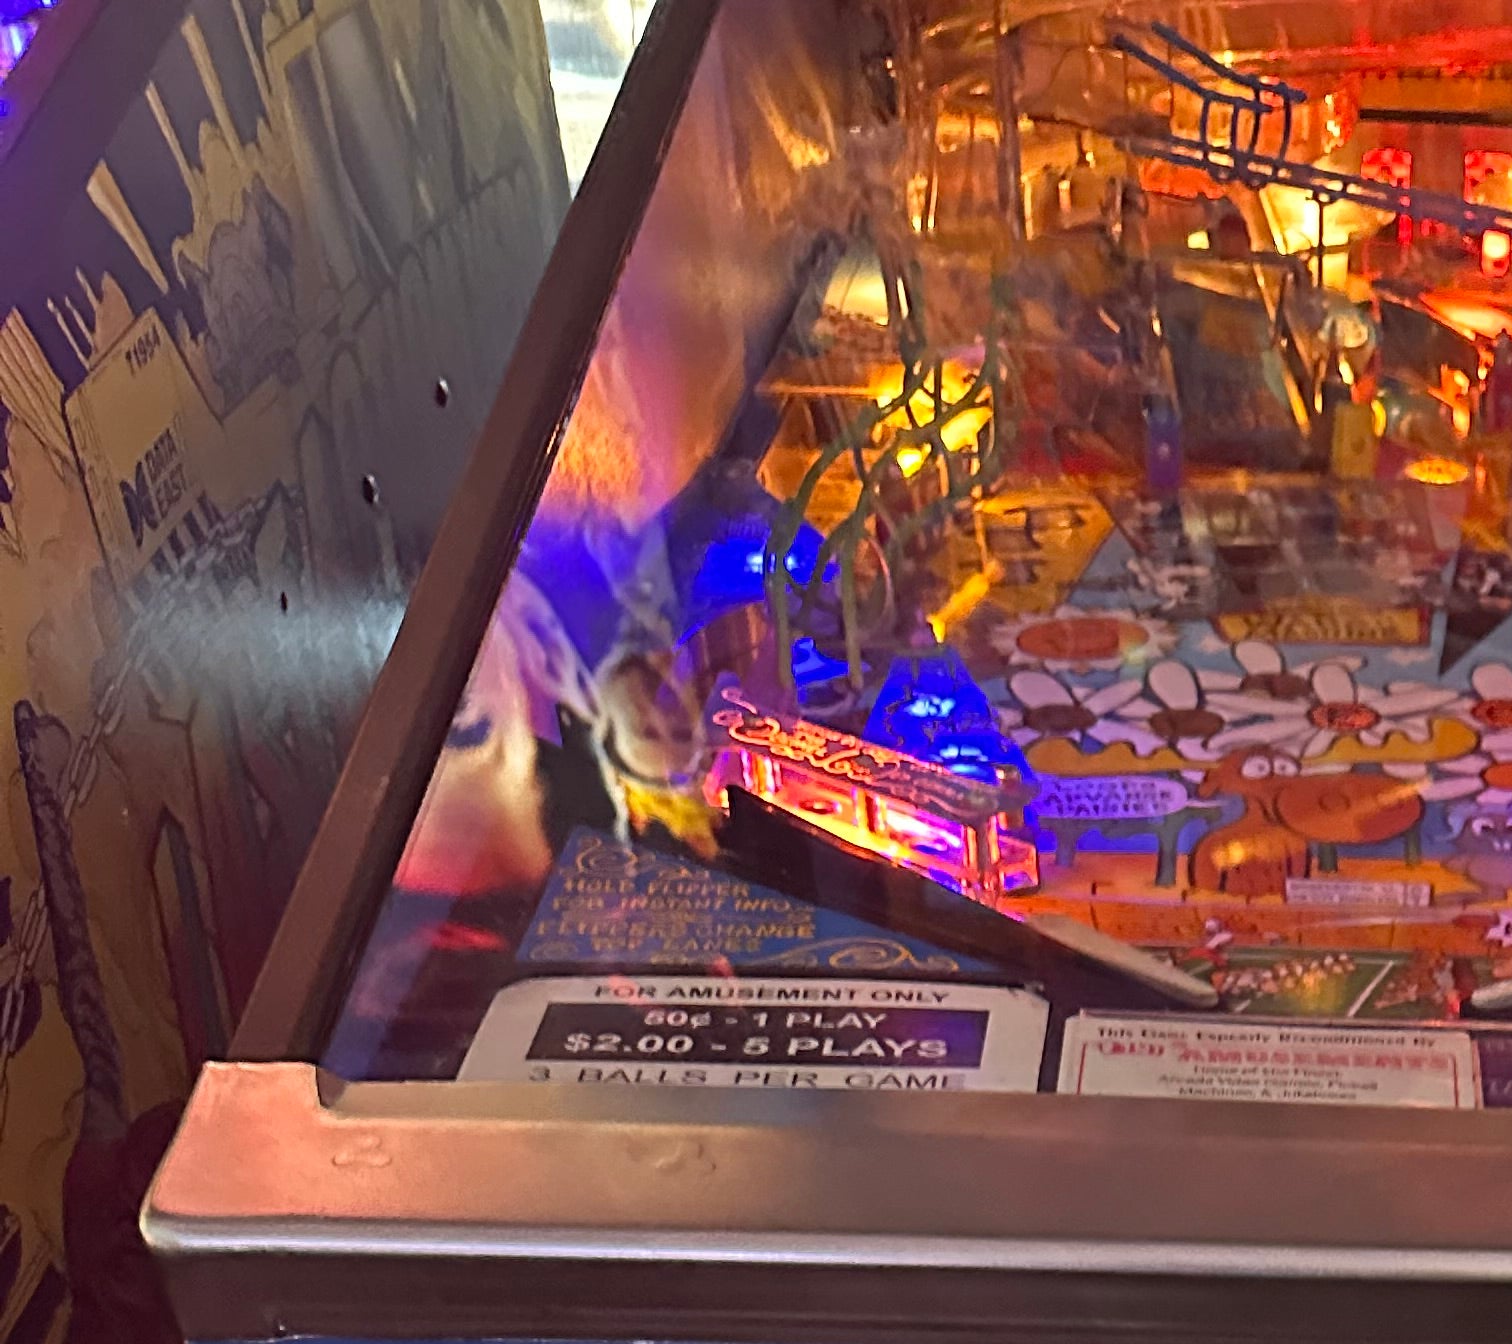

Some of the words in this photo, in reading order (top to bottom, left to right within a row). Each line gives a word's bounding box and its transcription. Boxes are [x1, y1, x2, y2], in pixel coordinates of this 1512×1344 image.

[145, 427, 178, 486] DATA
[155, 462, 188, 518] EAST
[594, 984, 659, 1000] FOR
[667, 985, 858, 1003] AMUSEMENT
[870, 988, 950, 1005] ONLY
[643, 1009, 713, 1031] 50¢
[752, 1012, 768, 1028] 1
[785, 1011, 889, 1030] PLAY
[563, 1031, 695, 1054] $2.00
[742, 1036, 771, 1056] 5
[785, 1036, 950, 1058] PLAYS
[577, 1067, 708, 1086] BALLS
[734, 1070, 819, 1087] PER
